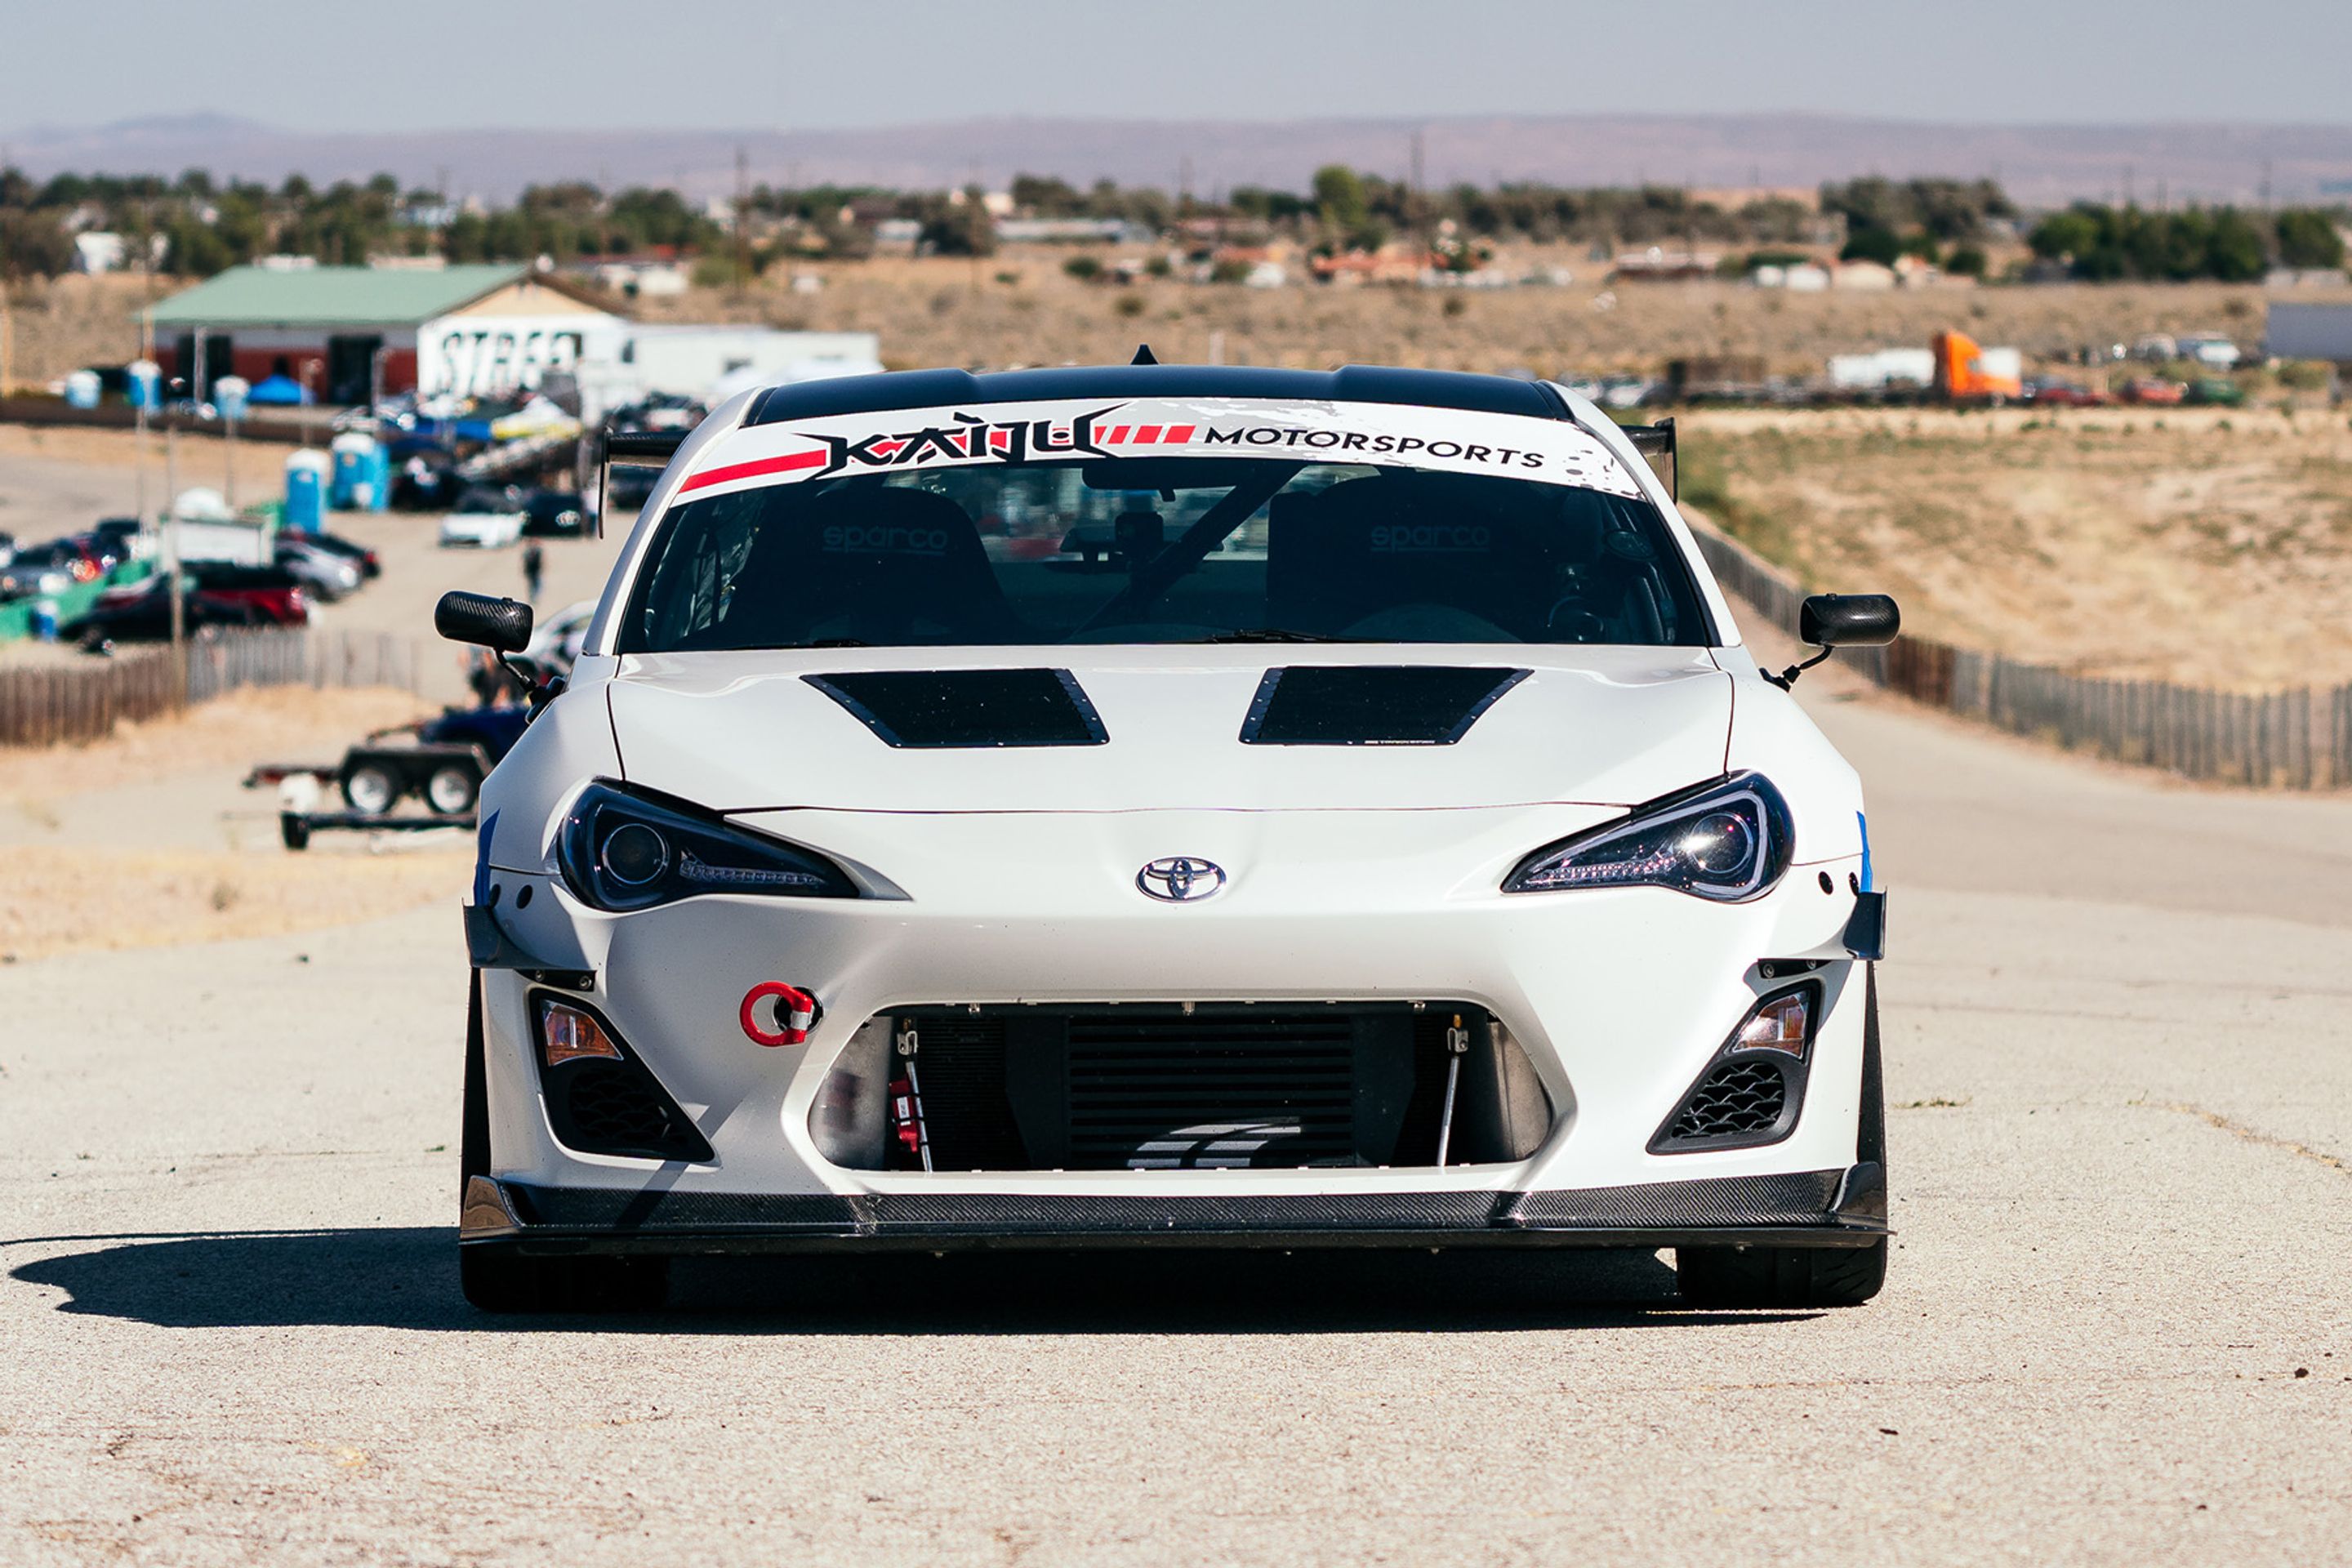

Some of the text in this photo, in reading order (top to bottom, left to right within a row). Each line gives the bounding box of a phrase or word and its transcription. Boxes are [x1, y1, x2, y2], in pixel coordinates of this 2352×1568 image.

[1204, 425, 1545, 469] MOTORSPORTS
[823, 525, 948, 553] sparco
[1371, 525, 1490, 553] sparco
